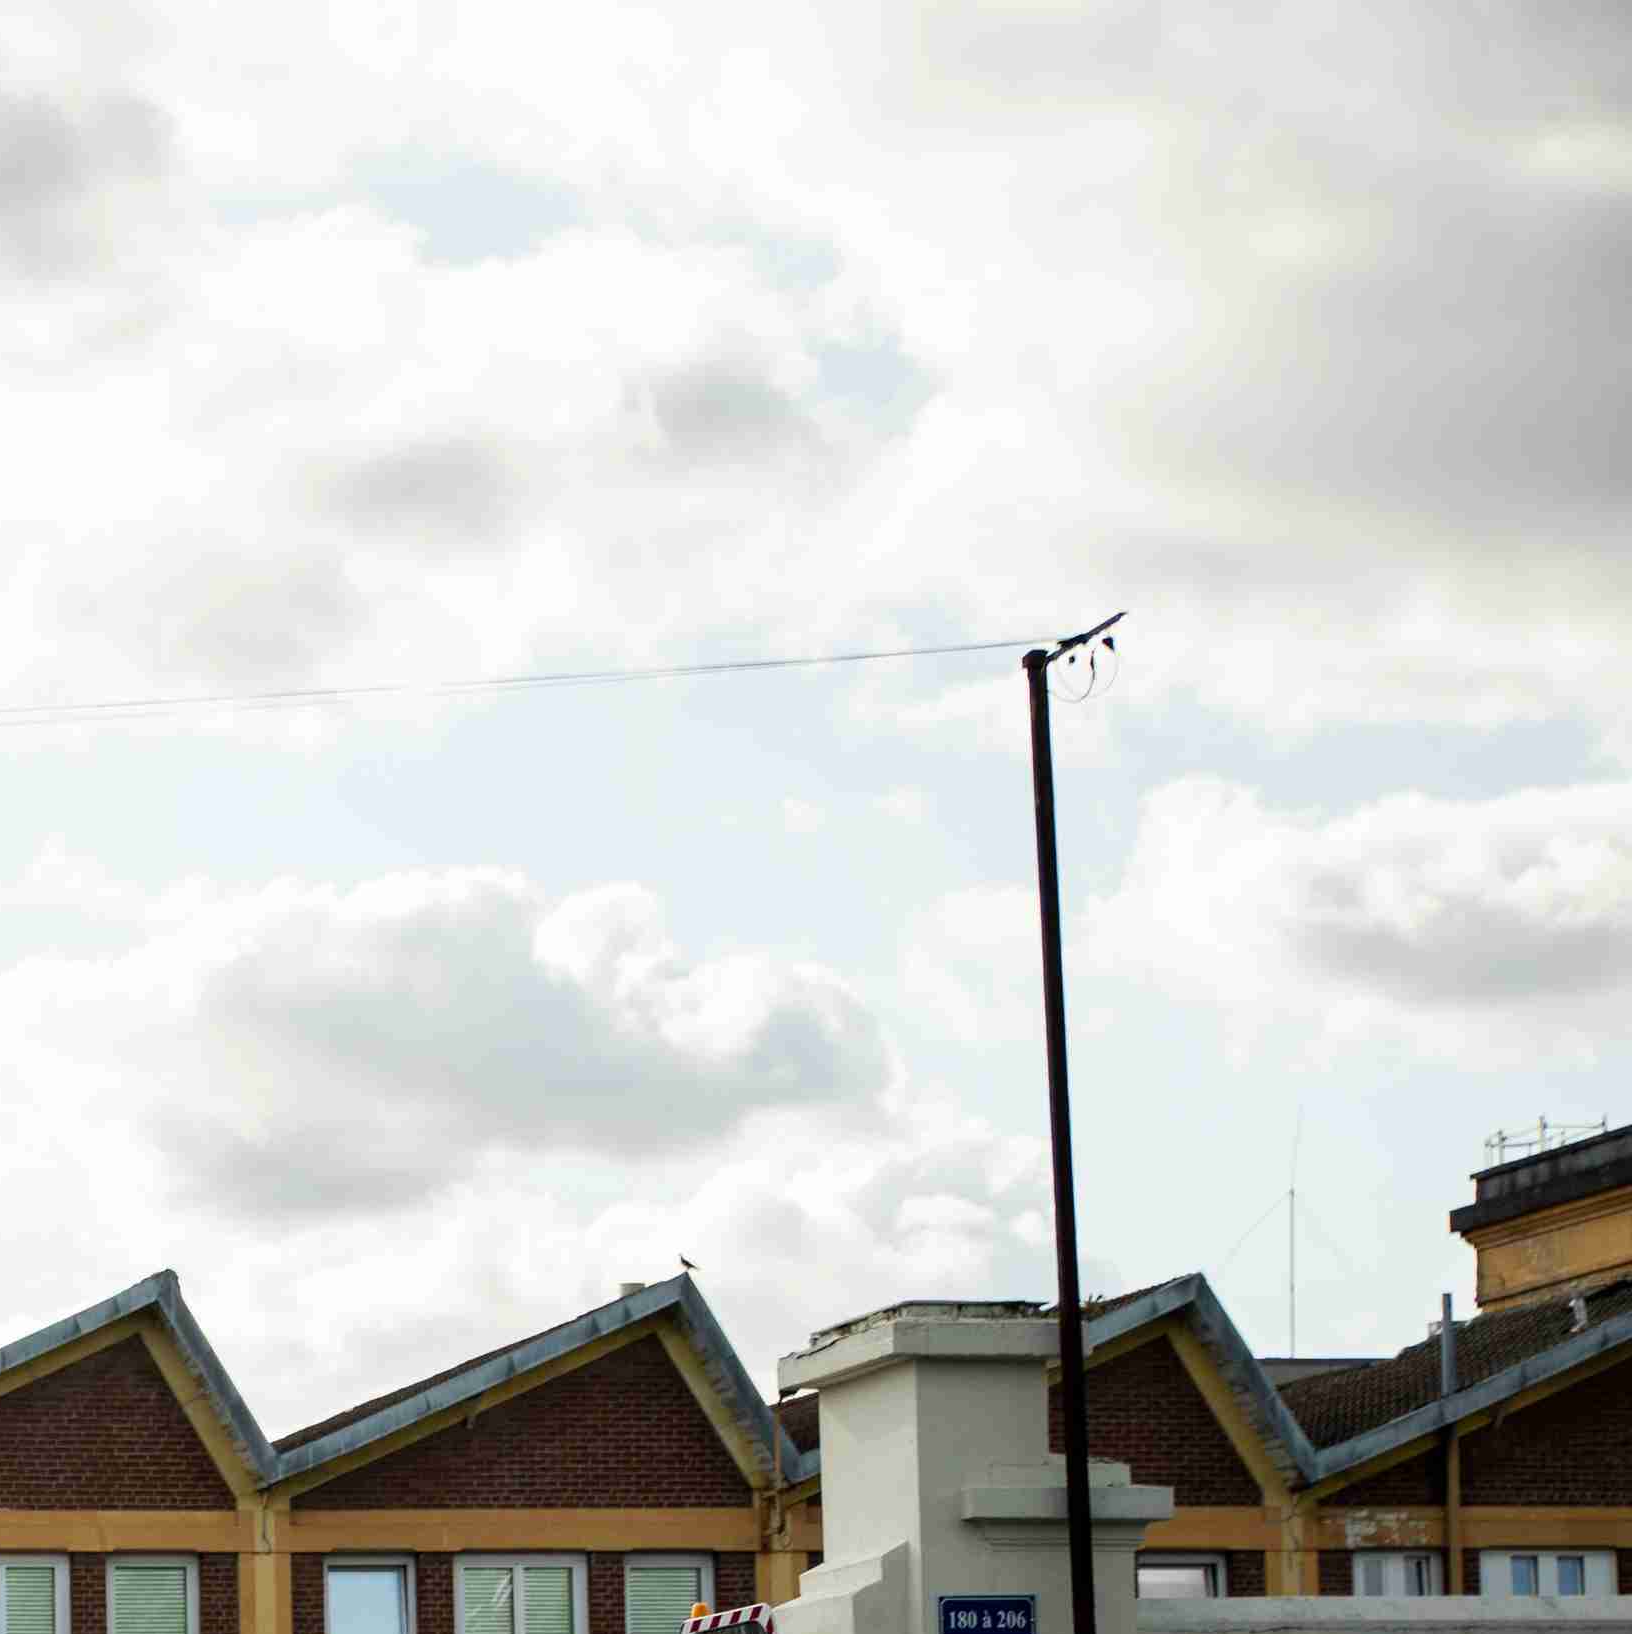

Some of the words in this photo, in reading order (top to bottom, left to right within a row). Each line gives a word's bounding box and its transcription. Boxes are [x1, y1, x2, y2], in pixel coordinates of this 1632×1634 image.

[949, 1610, 978, 1629] 180
[981, 1609, 993, 1629] à
[996, 1610, 1027, 1629] 206
